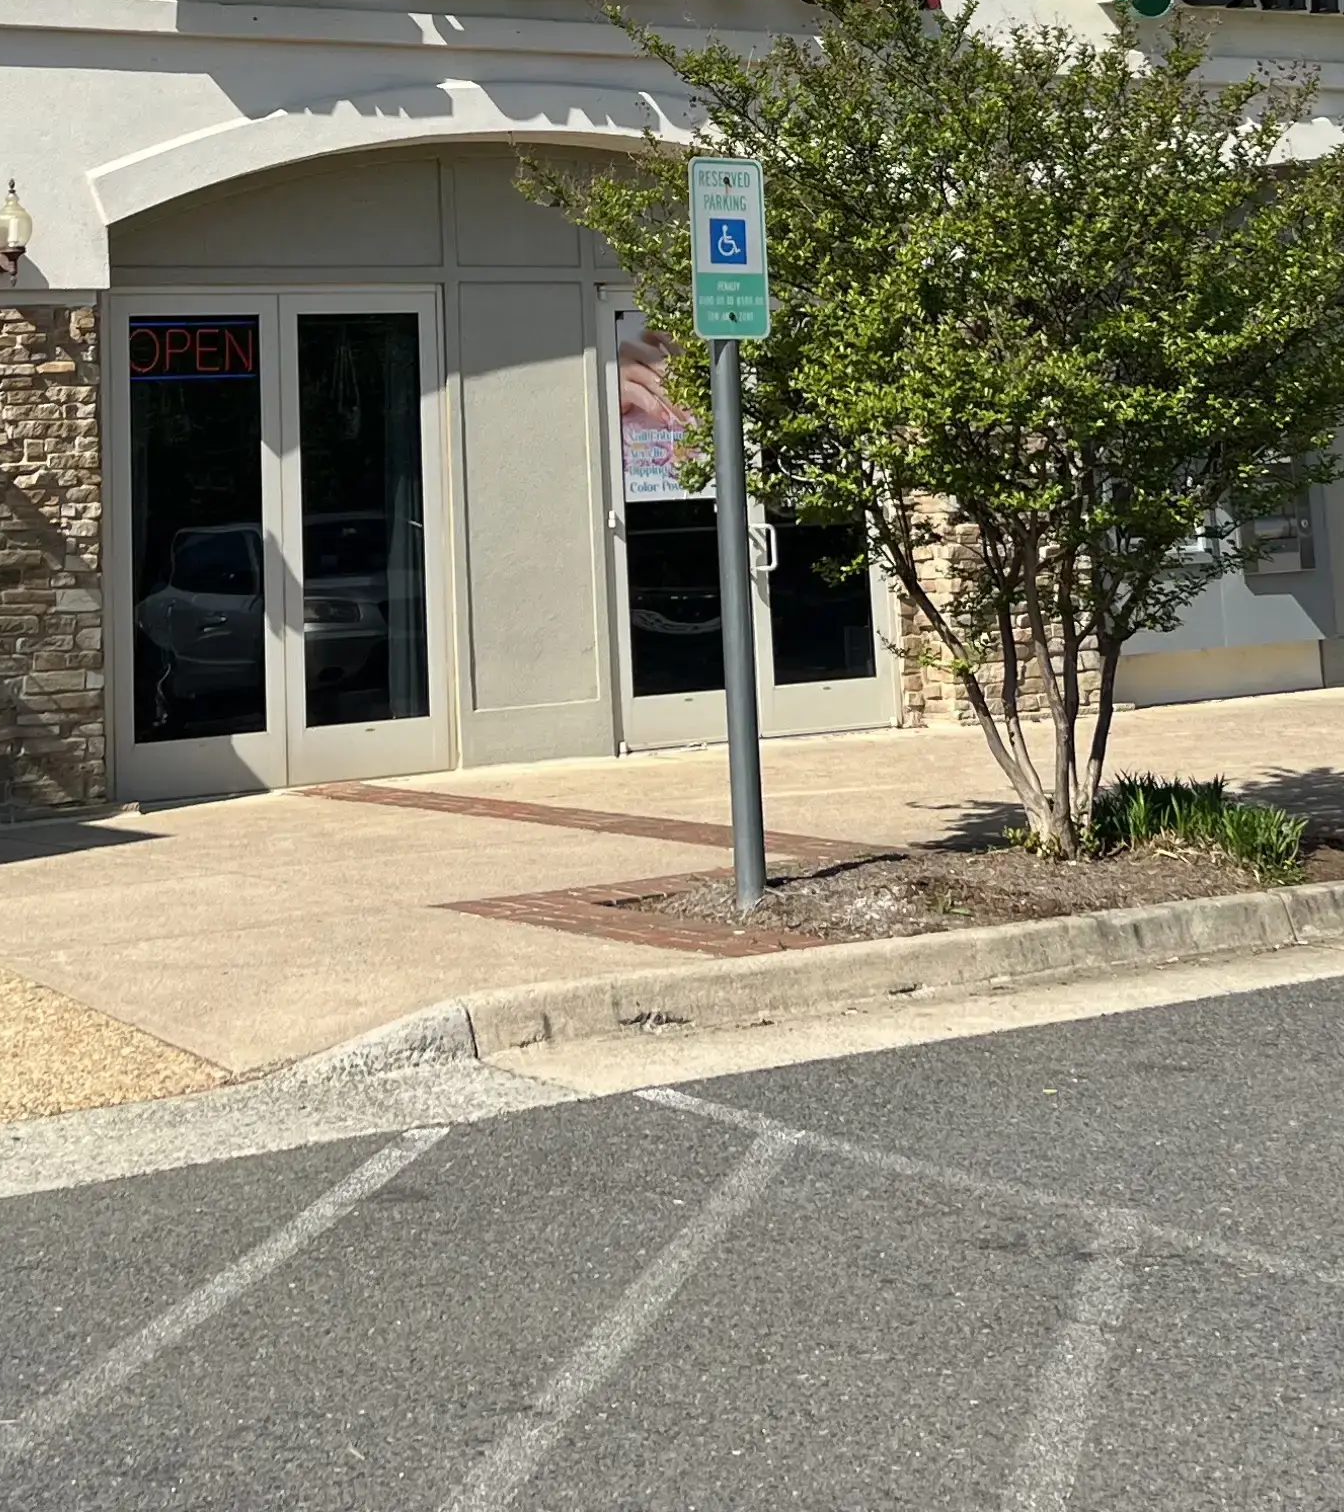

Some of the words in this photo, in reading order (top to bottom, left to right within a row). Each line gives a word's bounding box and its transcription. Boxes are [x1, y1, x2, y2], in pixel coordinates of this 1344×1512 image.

[698, 169, 751, 188] RESERVED
[703, 194, 747, 212] PARKING
[130, 328, 253, 373] OPEN
[630, 481, 660, 493] Color
